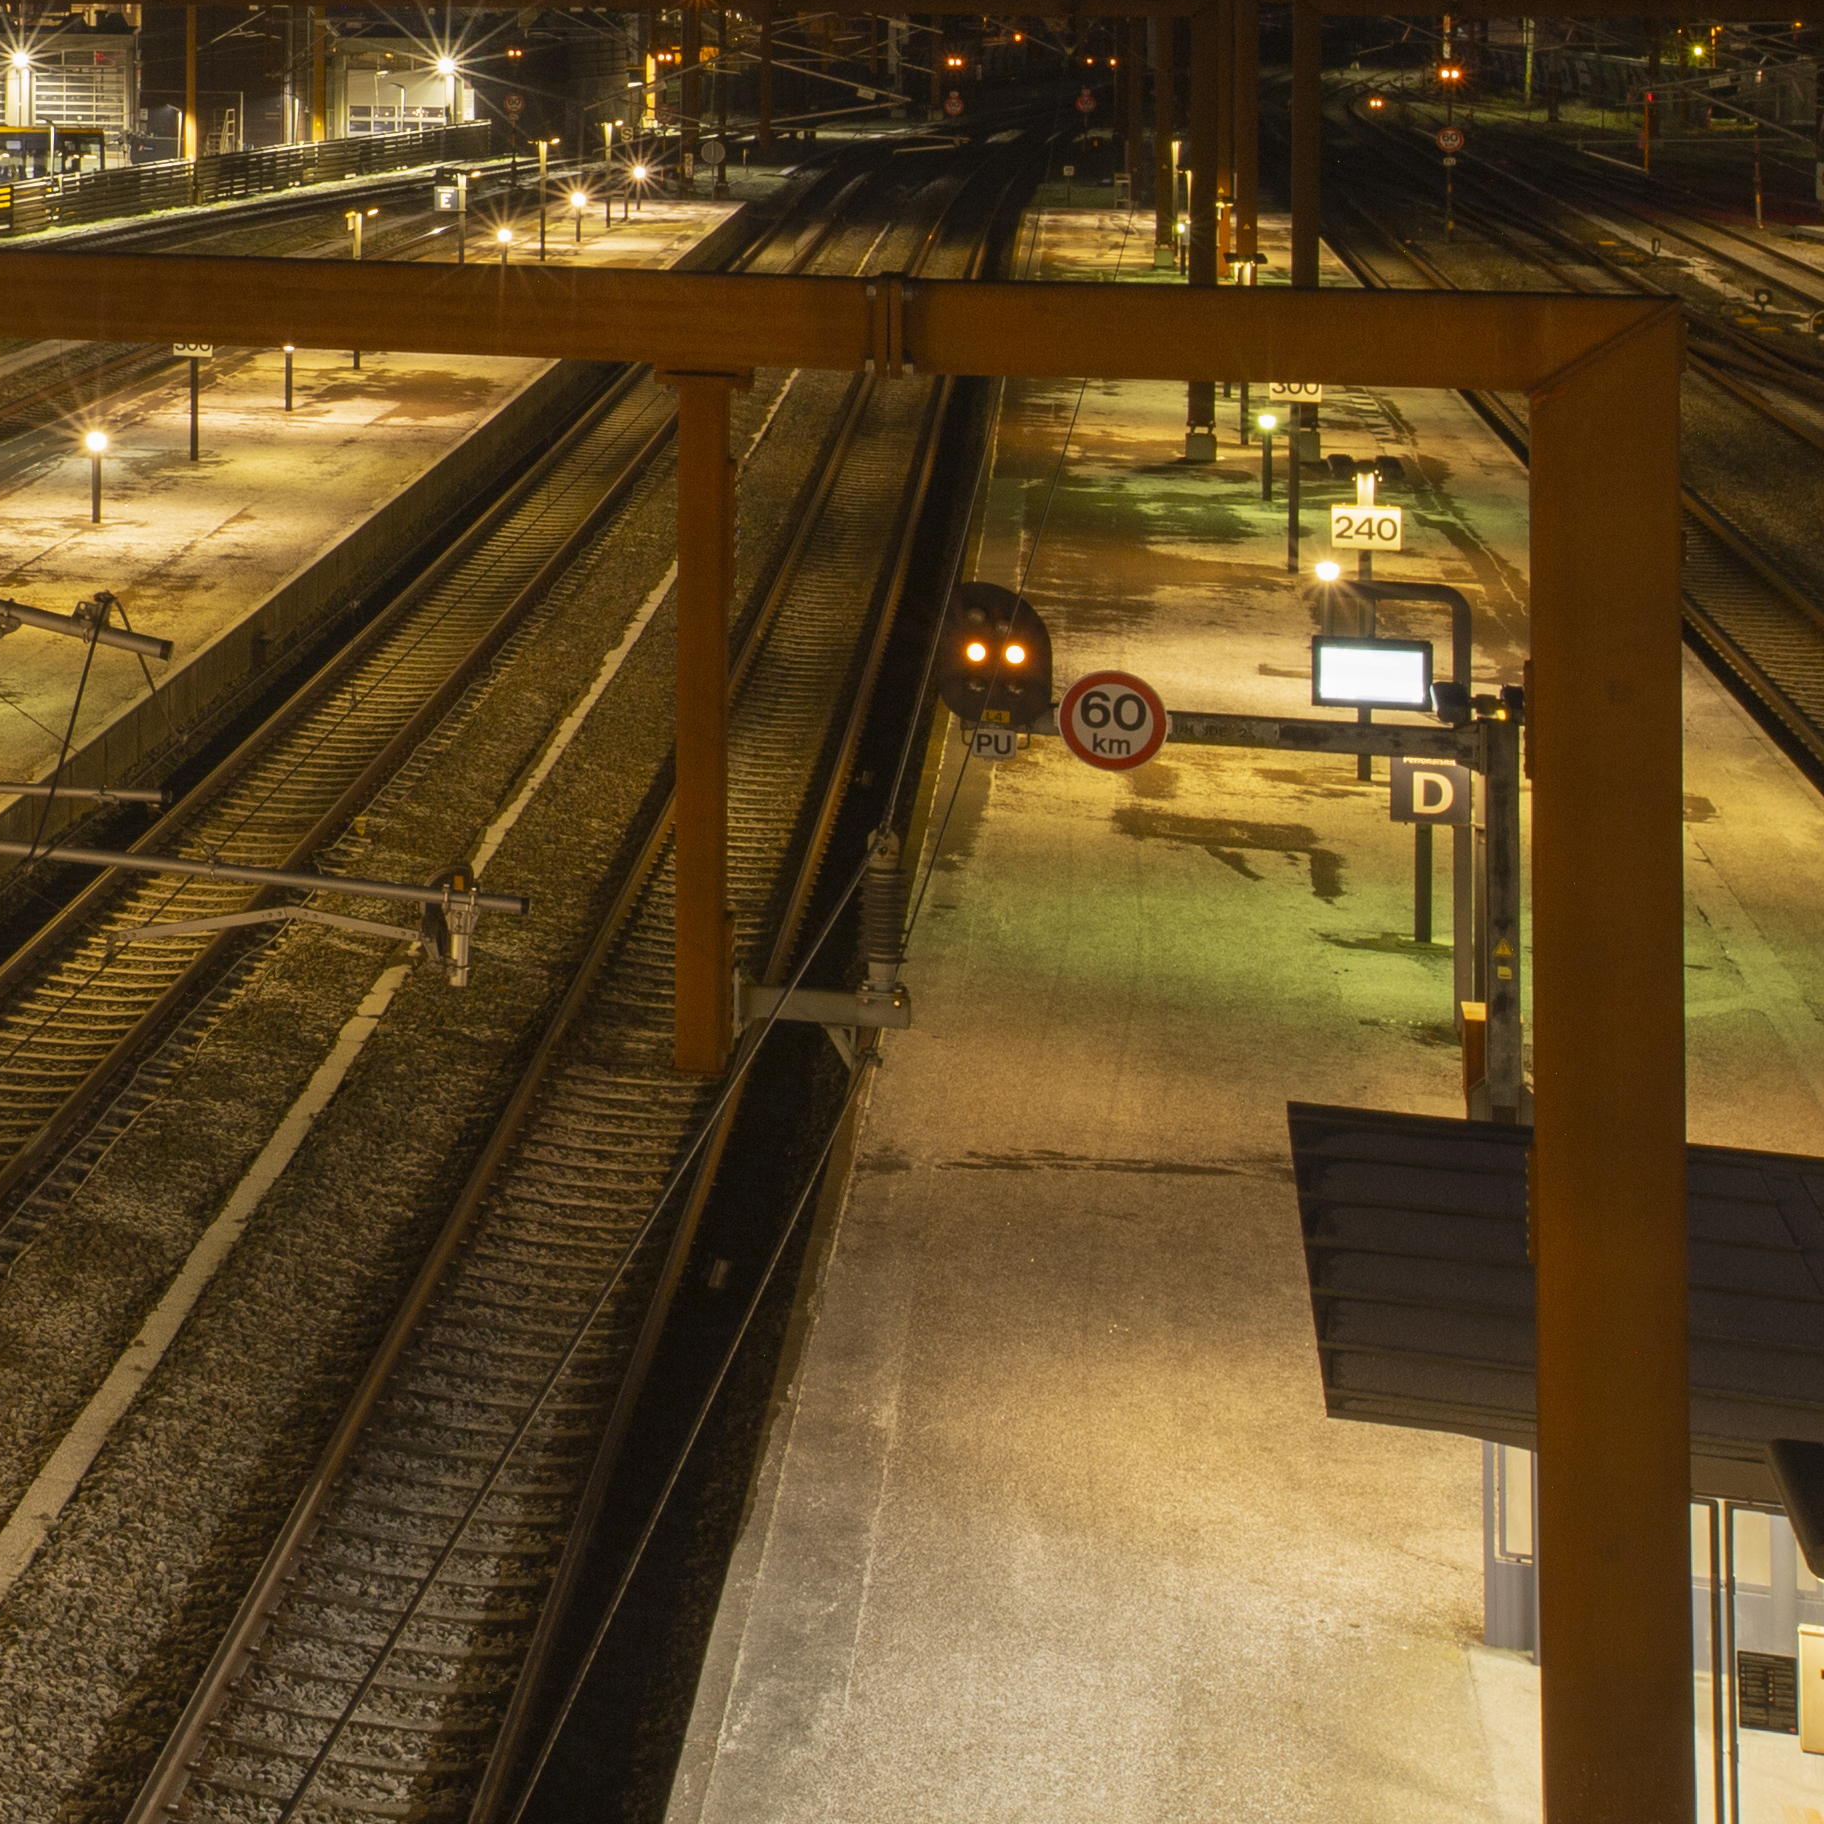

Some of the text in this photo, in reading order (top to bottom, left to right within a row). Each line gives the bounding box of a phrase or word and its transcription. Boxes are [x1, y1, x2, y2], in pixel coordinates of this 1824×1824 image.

[621, 128, 632, 141] S
[1441, 132, 1458, 142] 60
[440, 193, 452, 208] E
[1334, 515, 1398, 541] 240
[1079, 690, 1147, 732] 60
[976, 733, 1012, 755] PU
[1092, 732, 1131, 756] km
[1413, 771, 1454, 814] D
